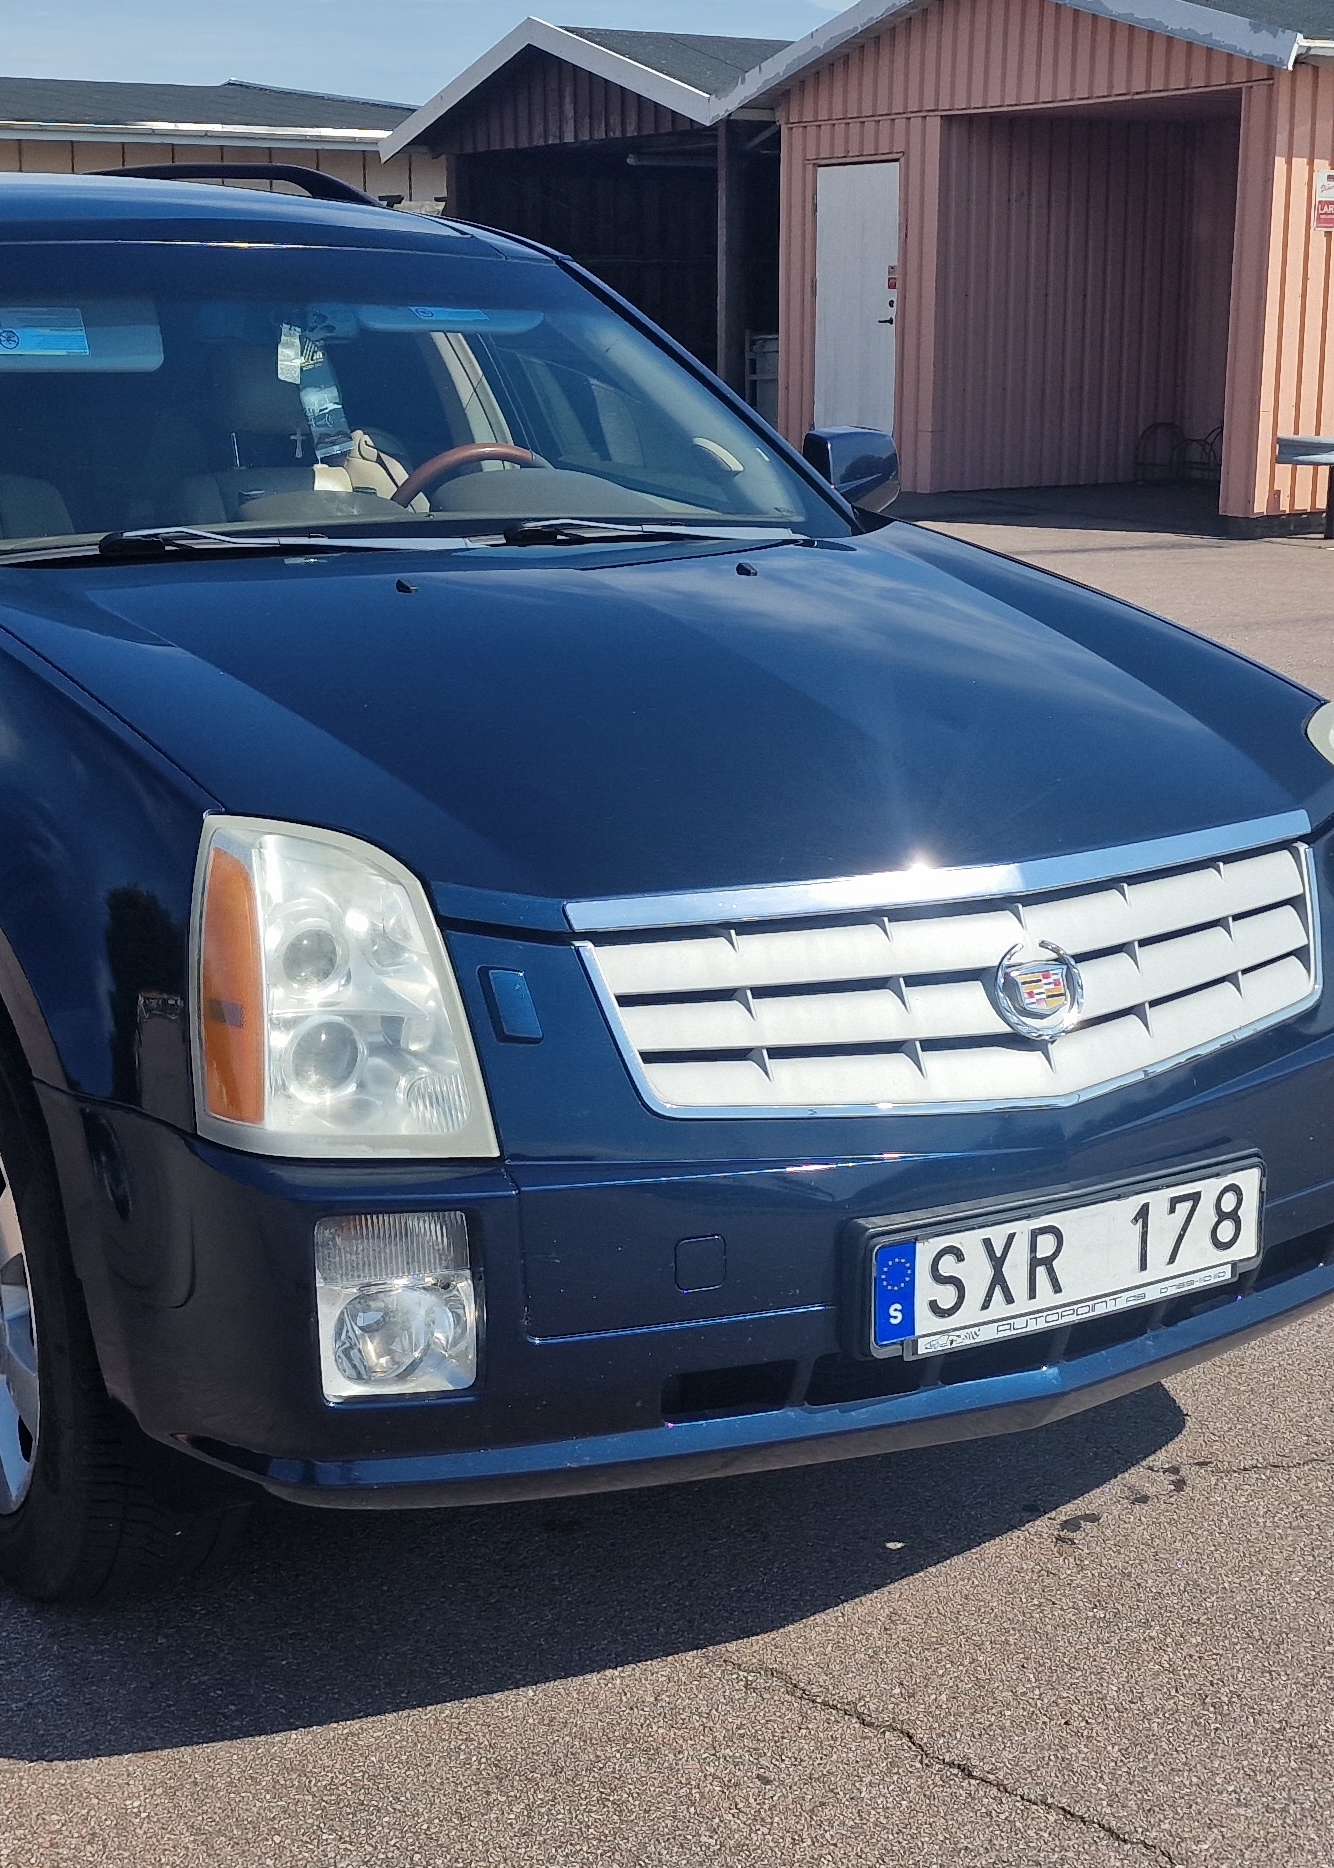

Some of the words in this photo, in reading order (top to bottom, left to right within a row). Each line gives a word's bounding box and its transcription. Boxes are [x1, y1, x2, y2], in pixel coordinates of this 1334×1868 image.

[928, 1224, 1064, 1319] SXR
[1130, 1183, 1244, 1272] 178
[888, 1303, 903, 1325] S
[996, 1296, 1123, 1335] AUTOPOINT
